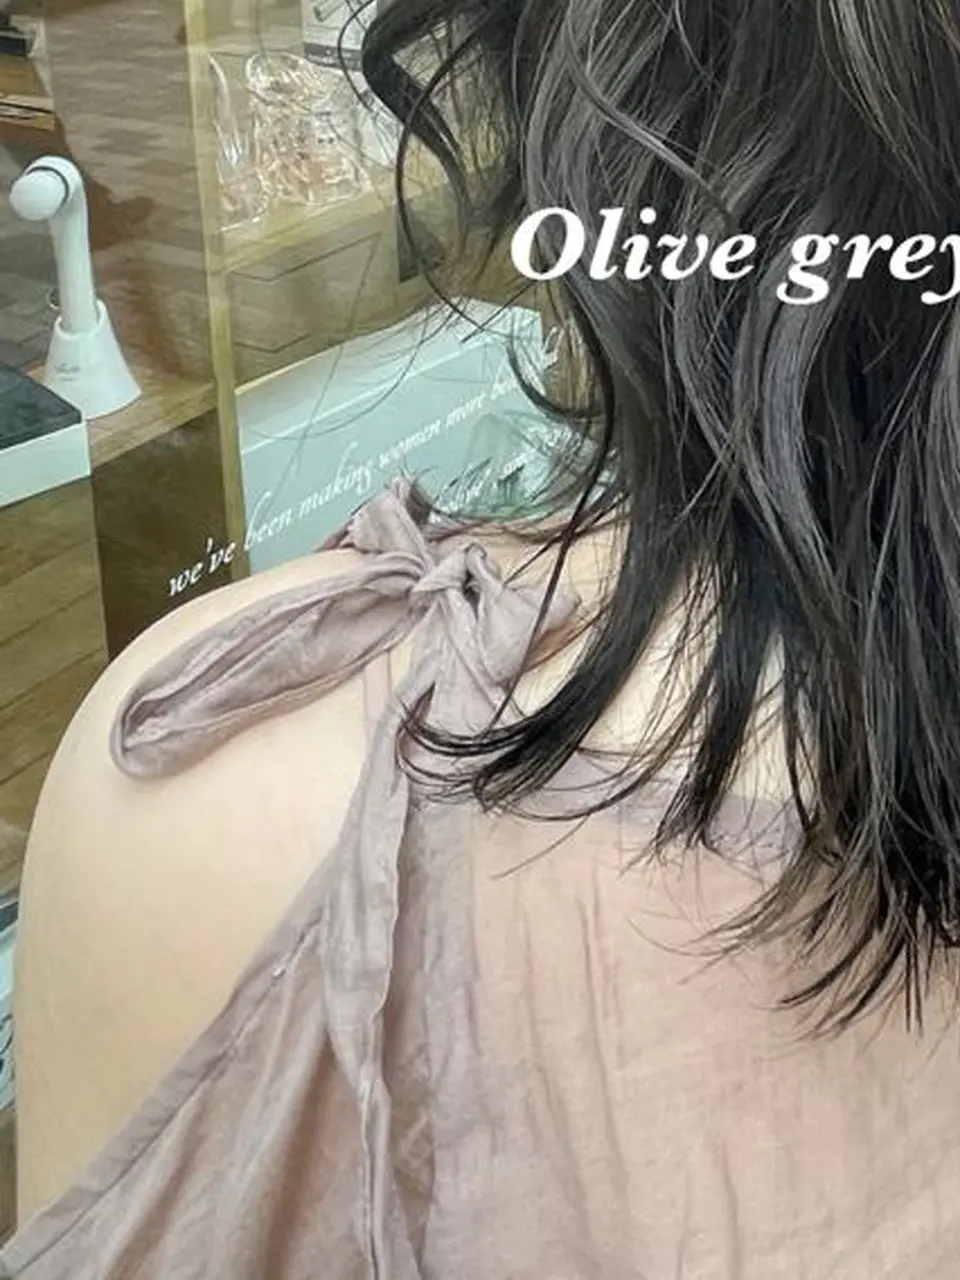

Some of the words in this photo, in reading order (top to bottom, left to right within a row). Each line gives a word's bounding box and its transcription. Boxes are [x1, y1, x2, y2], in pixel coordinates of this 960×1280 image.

[168, 537, 236, 597] we've
[243, 490, 292, 551] been
[299, 441, 373, 518] making
